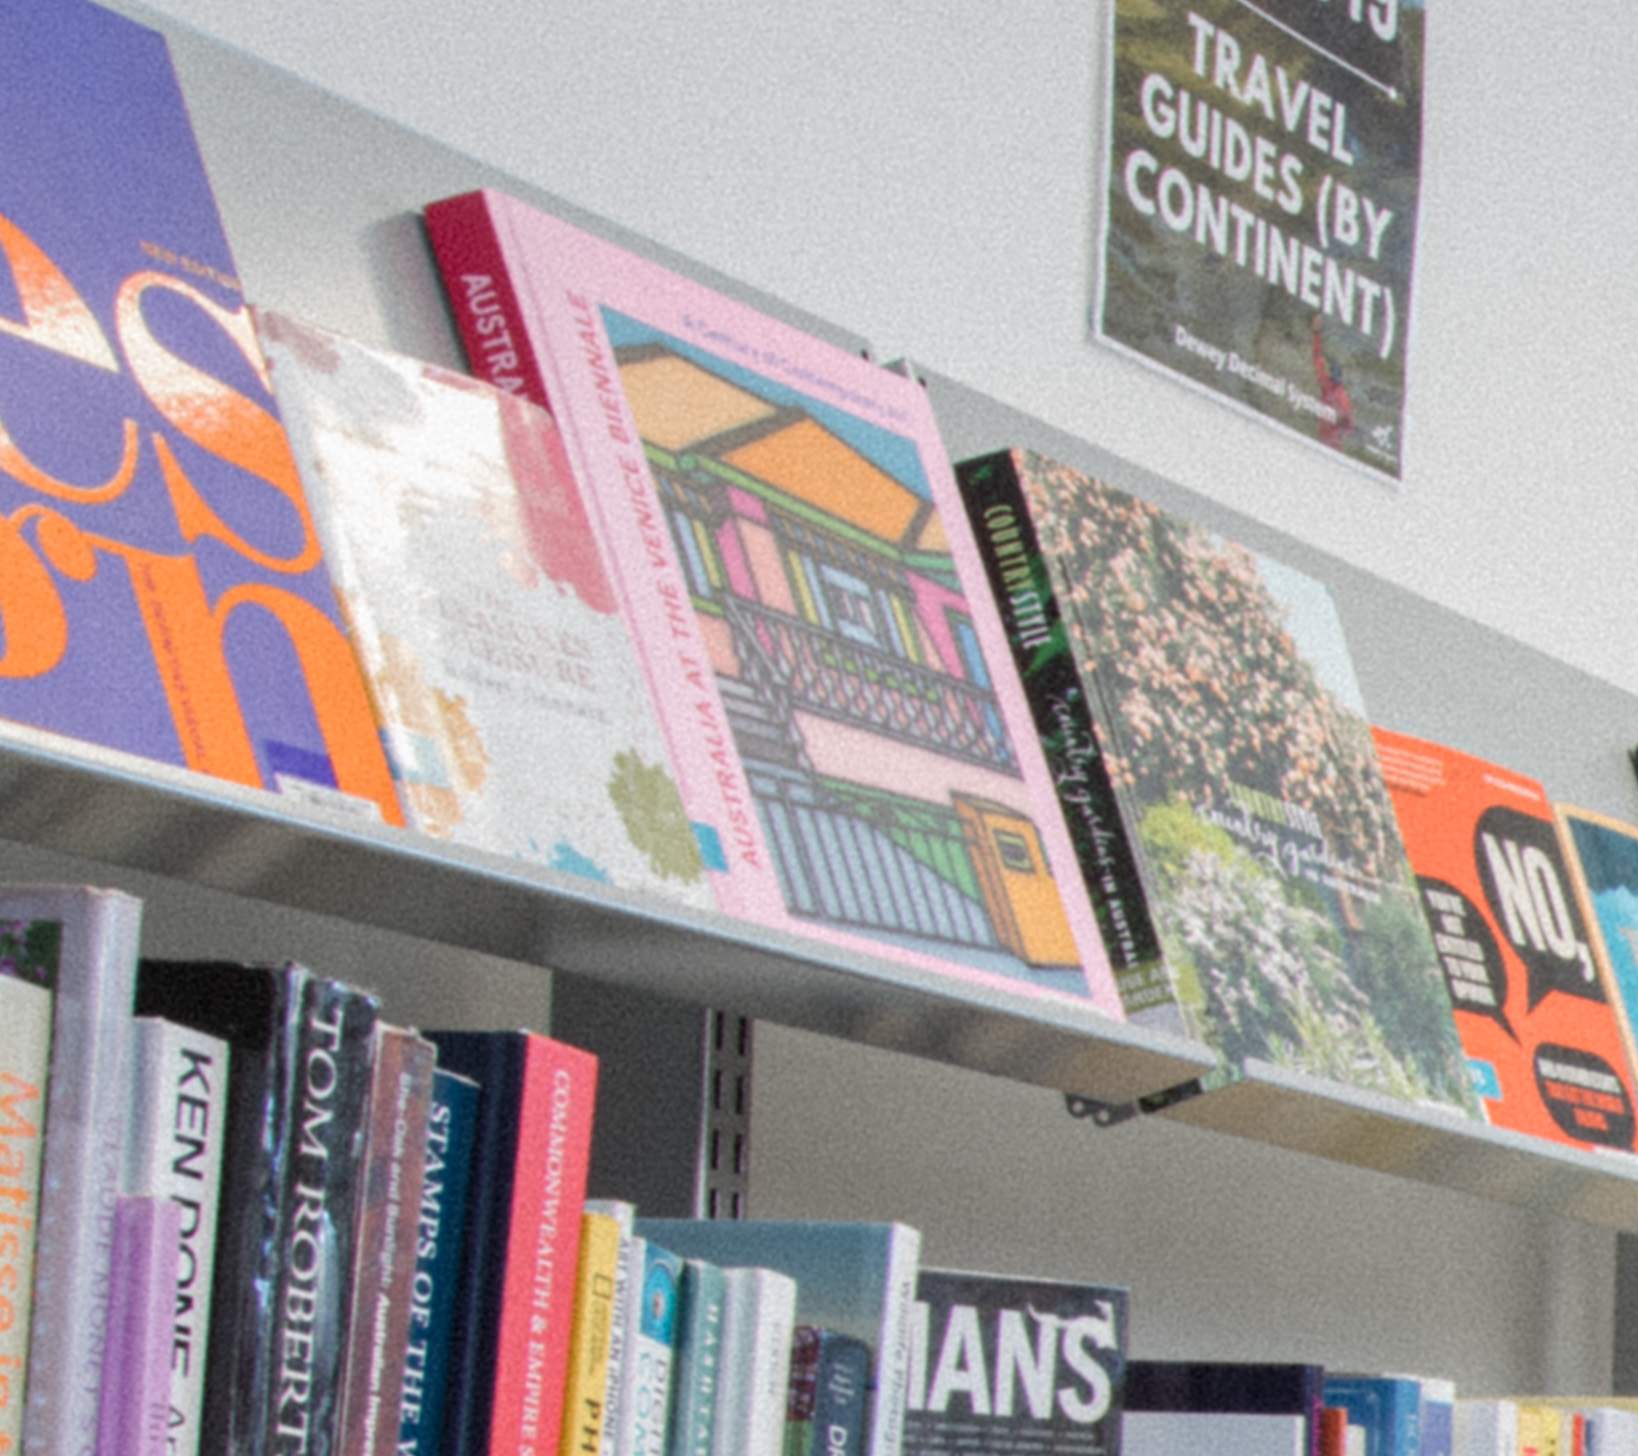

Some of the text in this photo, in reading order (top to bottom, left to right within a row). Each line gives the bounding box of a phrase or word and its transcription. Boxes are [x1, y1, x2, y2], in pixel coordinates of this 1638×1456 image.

[1189, 11, 1355, 166] TRAVEL
[1141, 73, 1392, 260] GUIDES (BY
[1125, 150, 1395, 359] CONTINENT)
[1175, 324, 1337, 423] Dewey Decimal System
[566, 289, 762, 868] AUSTRALIA AT THE VENICE BIENNALE
[169, 1046, 214, 1185] KEN
[296, 1005, 344, 1159] TOM
[414, 1103, 450, 1263] STAMPS
[531, 1069, 574, 1309] COMMONWEALTH
[411, 1272, 441, 1324] OF
[530, 1316, 548, 1334] &
[402, 1337, 434, 1421] THE
[519, 1342, 546, 1438] EMPIRE
